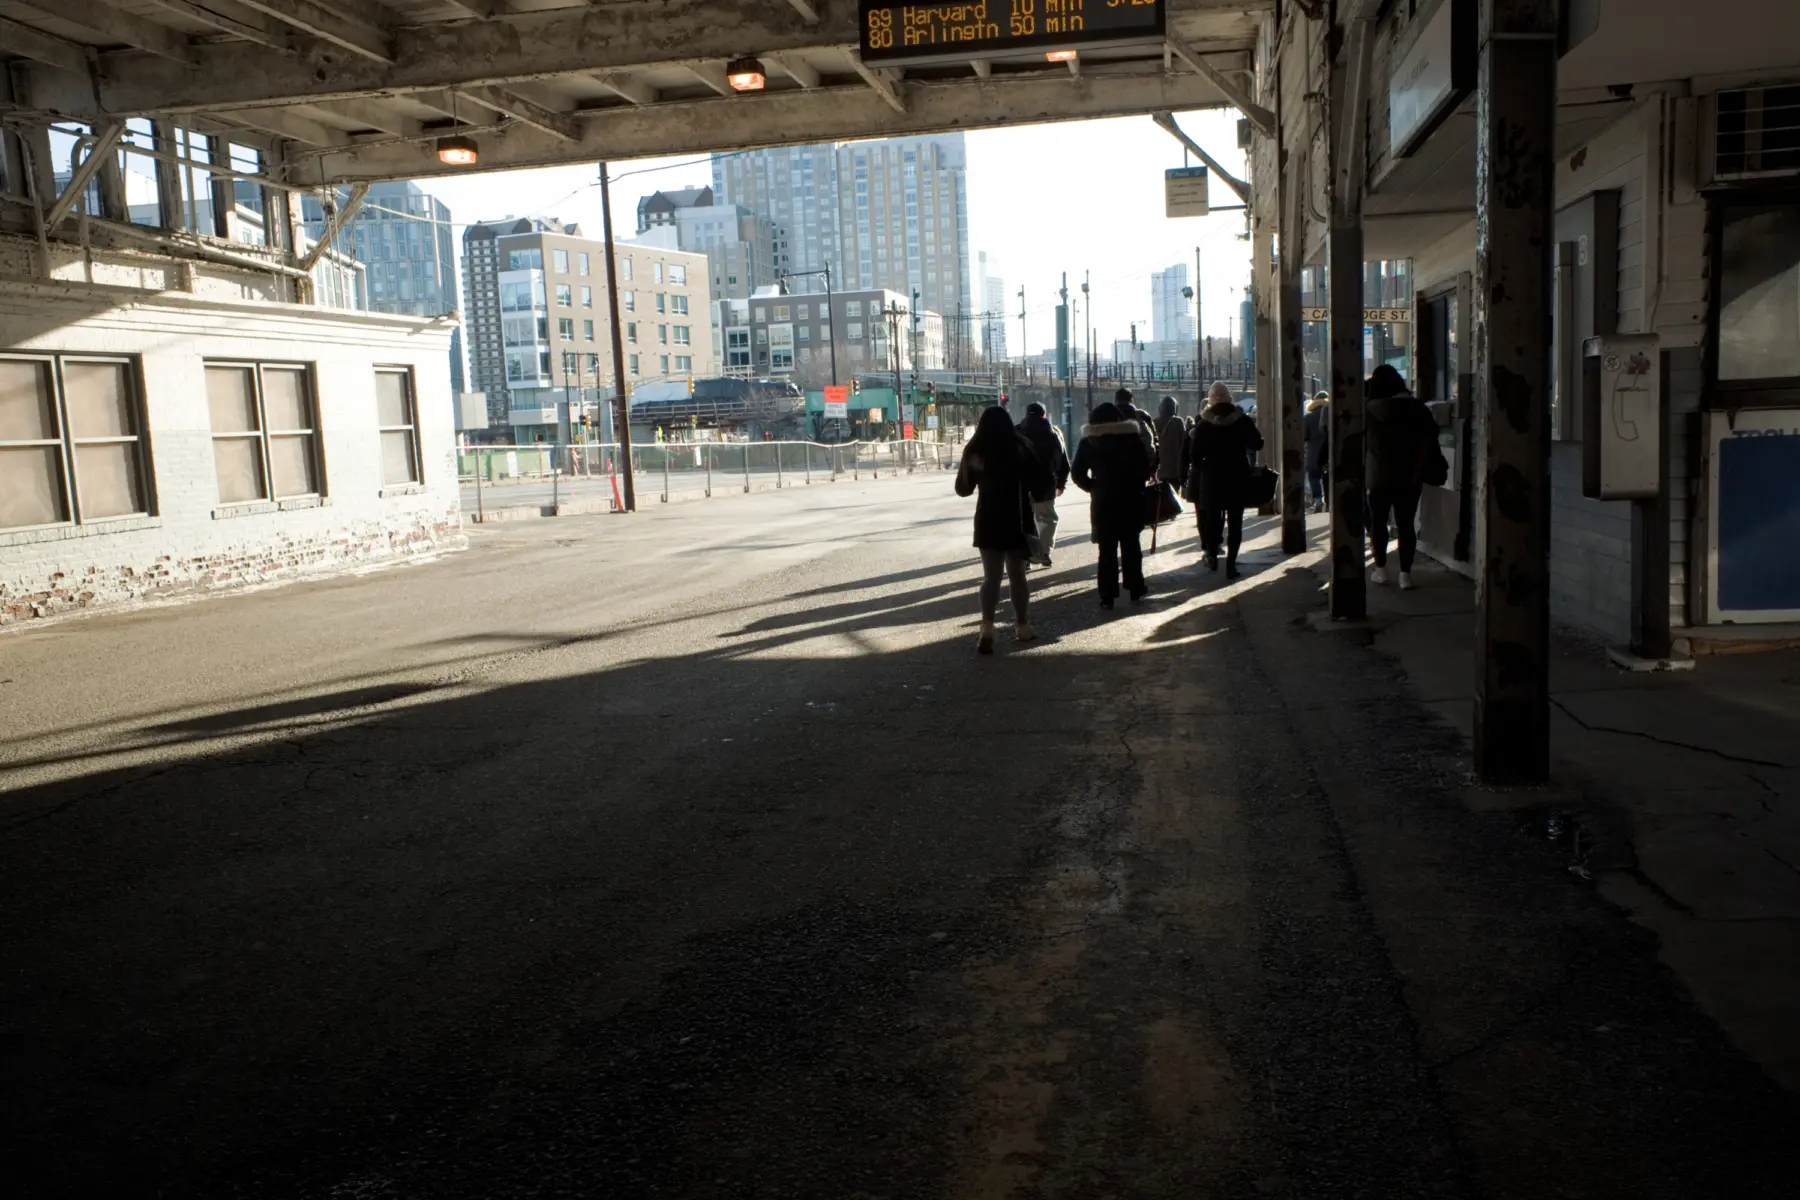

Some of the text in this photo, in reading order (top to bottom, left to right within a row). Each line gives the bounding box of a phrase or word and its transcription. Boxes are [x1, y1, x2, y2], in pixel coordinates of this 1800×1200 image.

[868, 0, 1083, 28] 69 Harvard 10 min
[869, 12, 1084, 48] 80 Arlingtn 50 min
[1390, 310, 1408, 320] ST.
